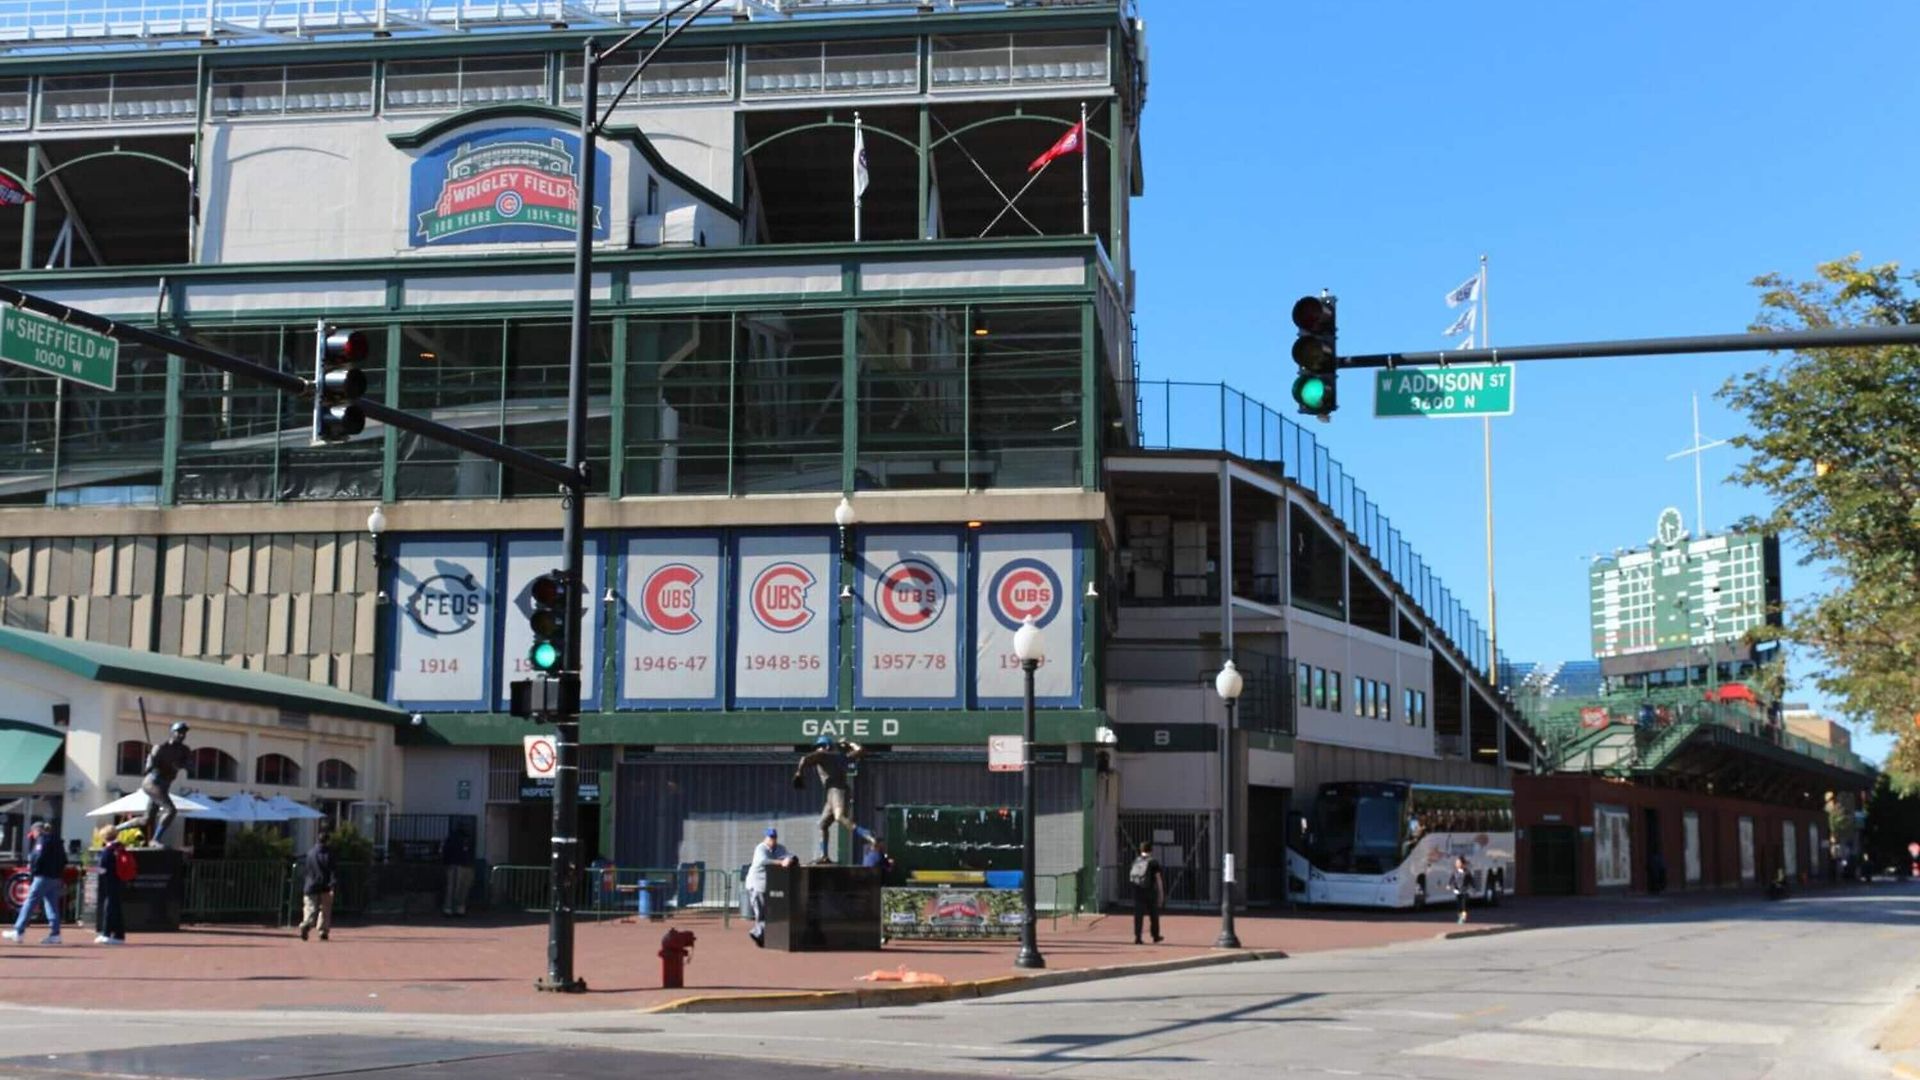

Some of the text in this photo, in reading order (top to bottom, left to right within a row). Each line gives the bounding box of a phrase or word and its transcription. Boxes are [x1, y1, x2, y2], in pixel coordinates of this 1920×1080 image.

[453, 173, 567, 203] WRIGLEY FIELD
[458, 209, 492, 227] YEARS
[527, 208, 578, 227] 1914-201
[6, 317, 111, 360] N SHEFFIELD AV
[35, 348, 82, 374] 1000 W
[1382, 372, 1506, 395] W ADDISON ST
[1411, 395, 1475, 410] 3600 N
[419, 658, 459, 674] 1914
[634, 655, 708, 671] 1946-47
[744, 654, 820, 670] 1948-56
[873, 653, 947, 670] 1957-78
[802, 719, 900, 737] GATE D
[1154, 729, 1170, 746] B
